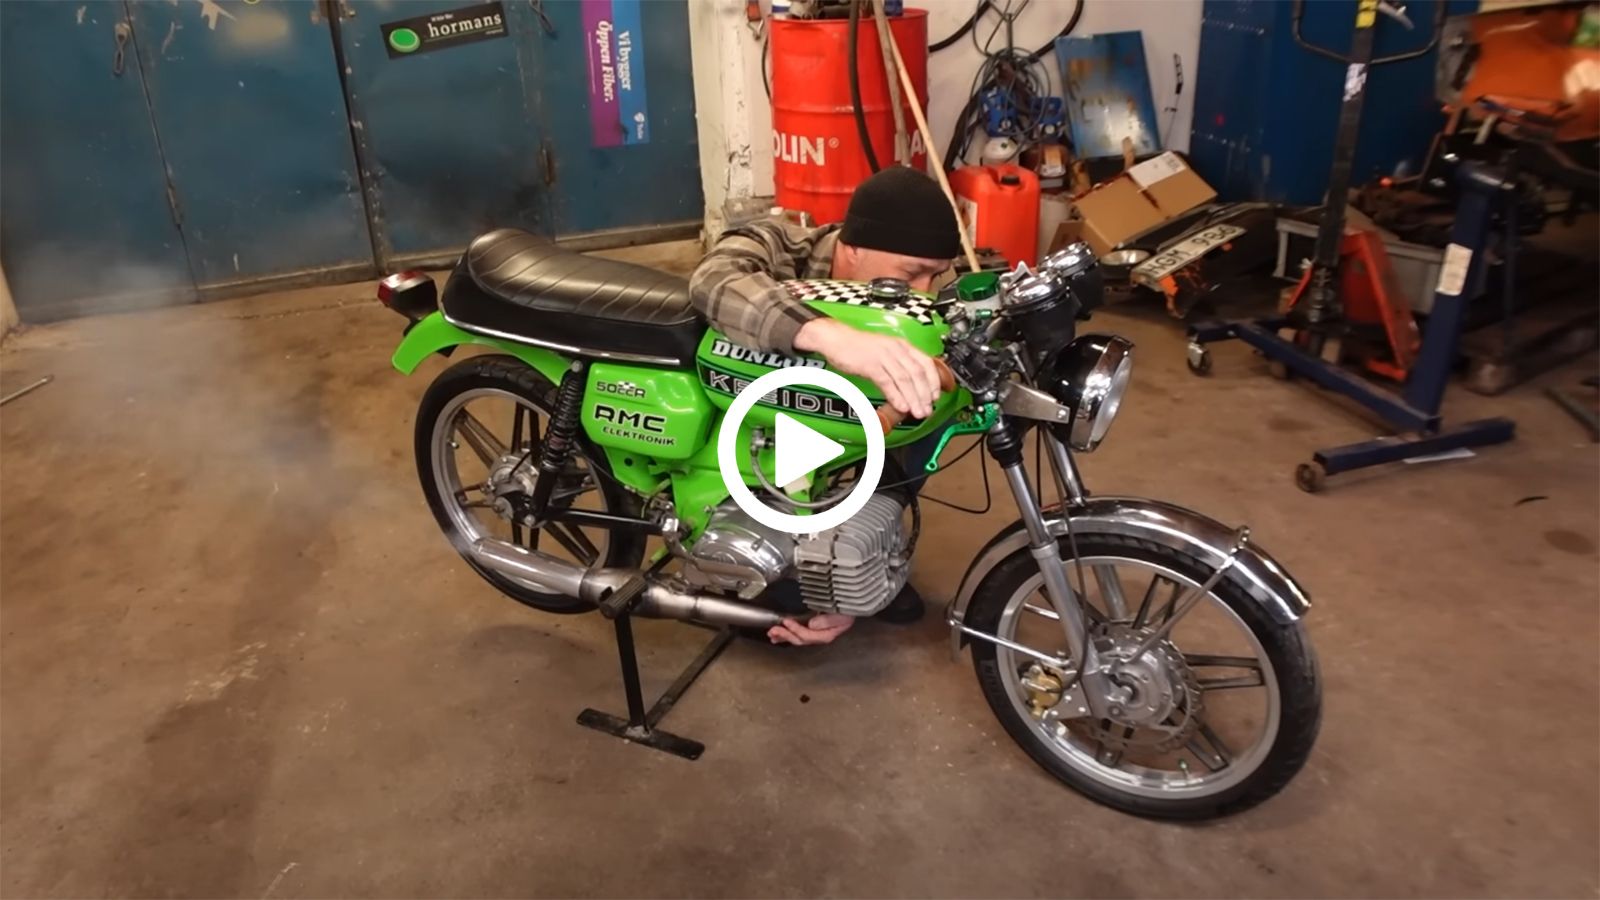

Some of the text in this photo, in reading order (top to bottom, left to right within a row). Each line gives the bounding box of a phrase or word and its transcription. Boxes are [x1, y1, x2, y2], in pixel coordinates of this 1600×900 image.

[427, 13, 502, 38] hormans
[596, 21, 616, 103] Öppen Fiber.
[617, 31, 631, 91] Vi bygger
[1141, 249, 1192, 275] HGM
[709, 370, 862, 420] KEIDL
[594, 404, 666, 433] RMC
[602, 426, 676, 446] ELEKTRONIK
